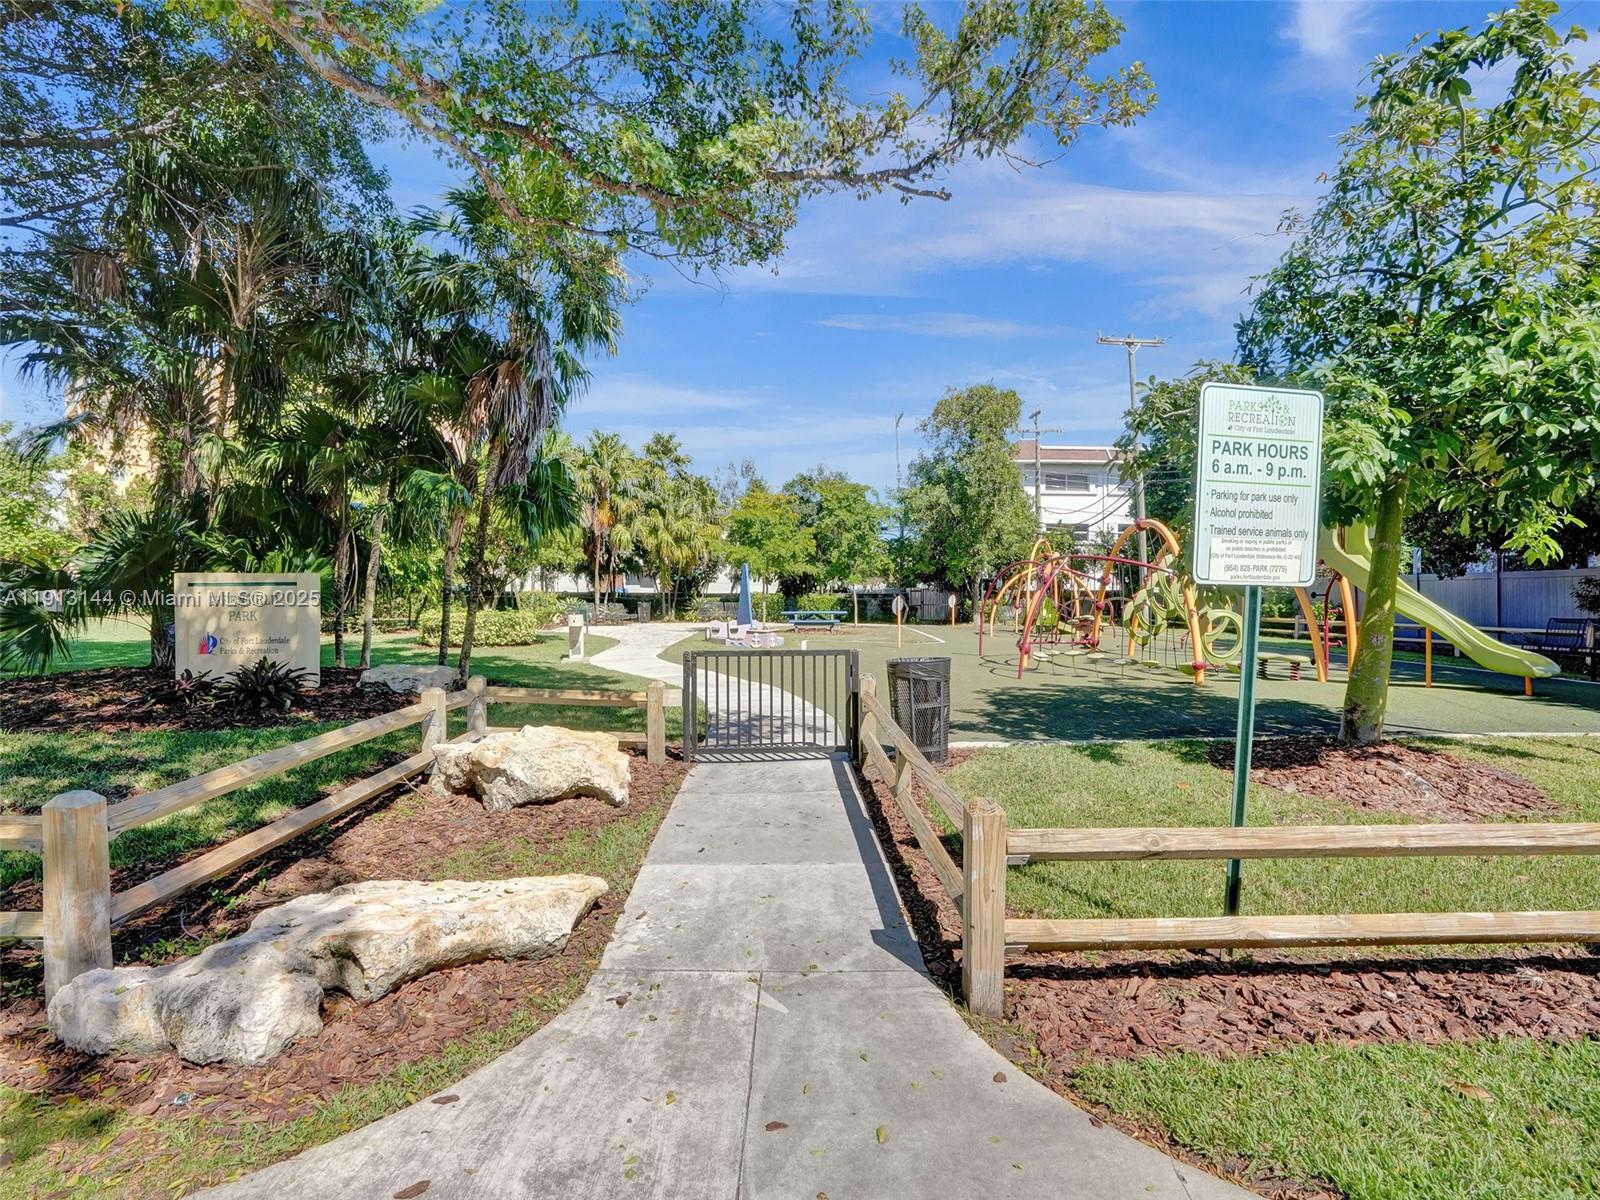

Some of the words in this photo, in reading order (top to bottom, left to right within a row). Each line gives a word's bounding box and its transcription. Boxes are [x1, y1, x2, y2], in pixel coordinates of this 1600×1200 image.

[1229, 400, 1263, 412] PARKS
[1228, 410, 1296, 426] RECREATION
[1212, 440, 1253, 456] PARK
[1257, 443, 1308, 460] HOURS
[1212, 459, 1219, 473] 6
[1224, 463, 1252, 475] a.m.
[1266, 463, 1273, 476] 9
[1278, 466, 1306, 480] p.m.
[1211, 489, 1238, 503] Parking
[1240, 491, 1249, 501] for
[1251, 492, 1267, 503] park
[1283, 494, 1298, 505] only
[1210, 507, 1236, 518] Alcohol
[1238, 509, 1273, 520] prohibited
[1210, 524, 1236, 536] Trained
[1238, 527, 1263, 536] service
[1265, 528, 1292, 537] animals
[1294, 529, 1309, 540] only
[1224, 564, 1238, 573] (954)
[1270, 565, 1287, 574] (7275)
[228, 611, 257, 621] PARK
[220, 637, 232, 646] City
